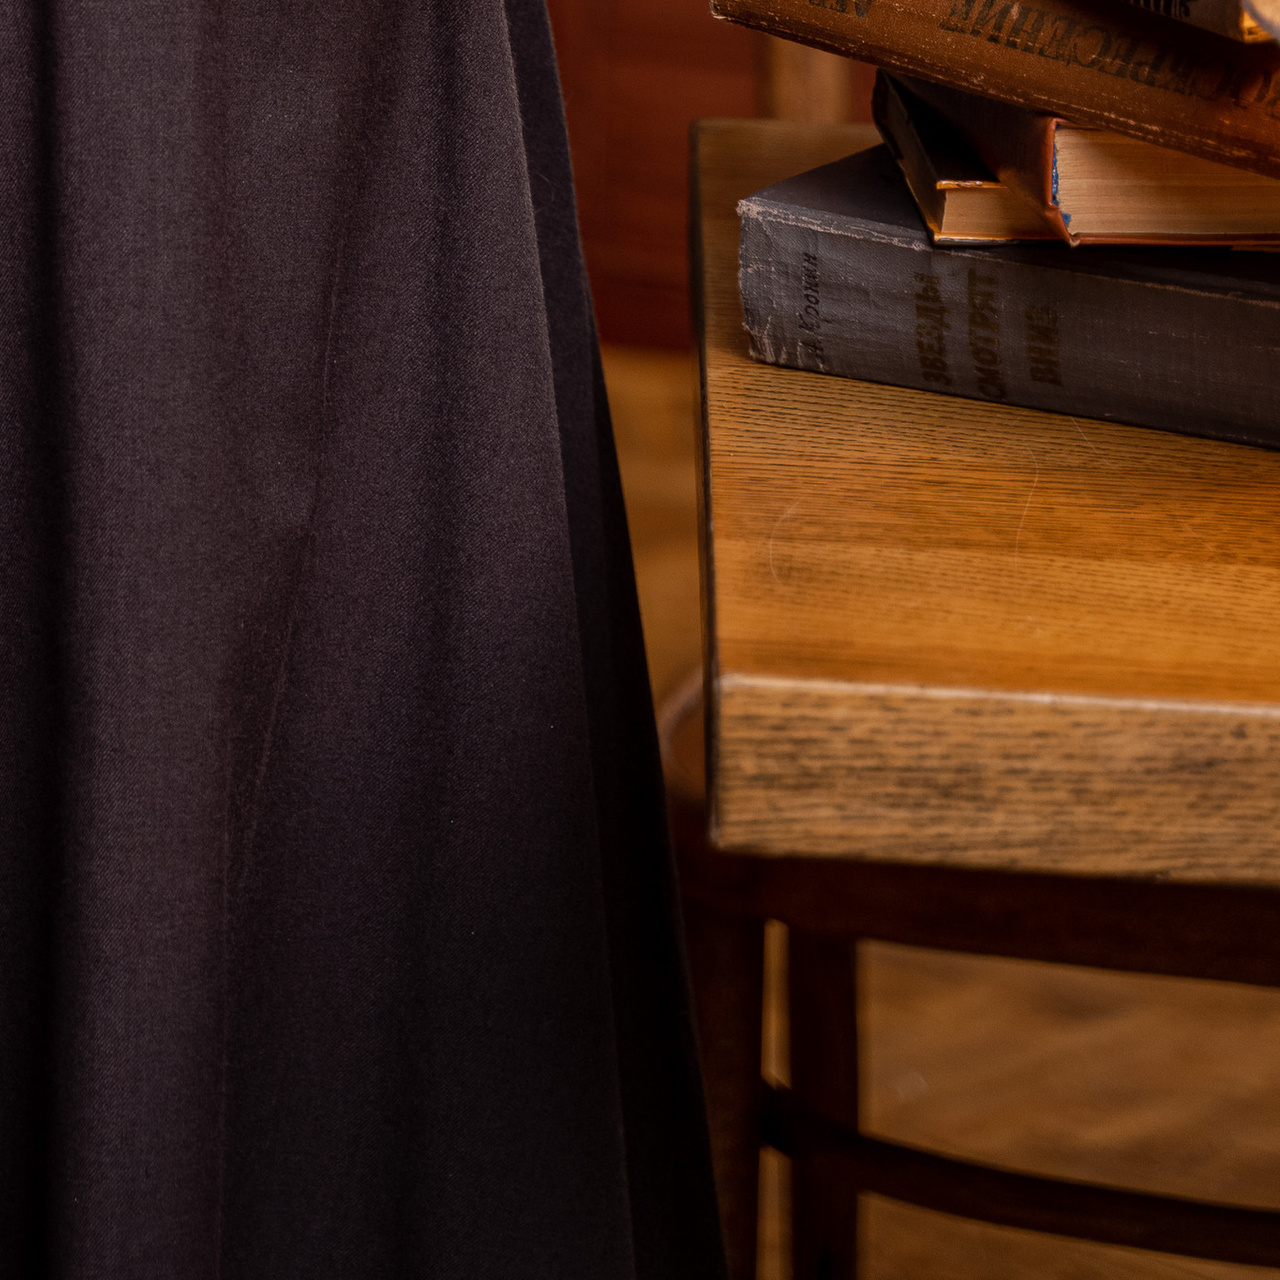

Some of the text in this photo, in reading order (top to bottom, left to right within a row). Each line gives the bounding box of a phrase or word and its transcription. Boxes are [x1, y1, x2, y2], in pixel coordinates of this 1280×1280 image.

[913, 273, 952, 386] ЗВЕЗДЫ
[968, 266, 1007, 401] СМОТРЯТ
[1025, 303, 1064, 386] ВНИЗ
